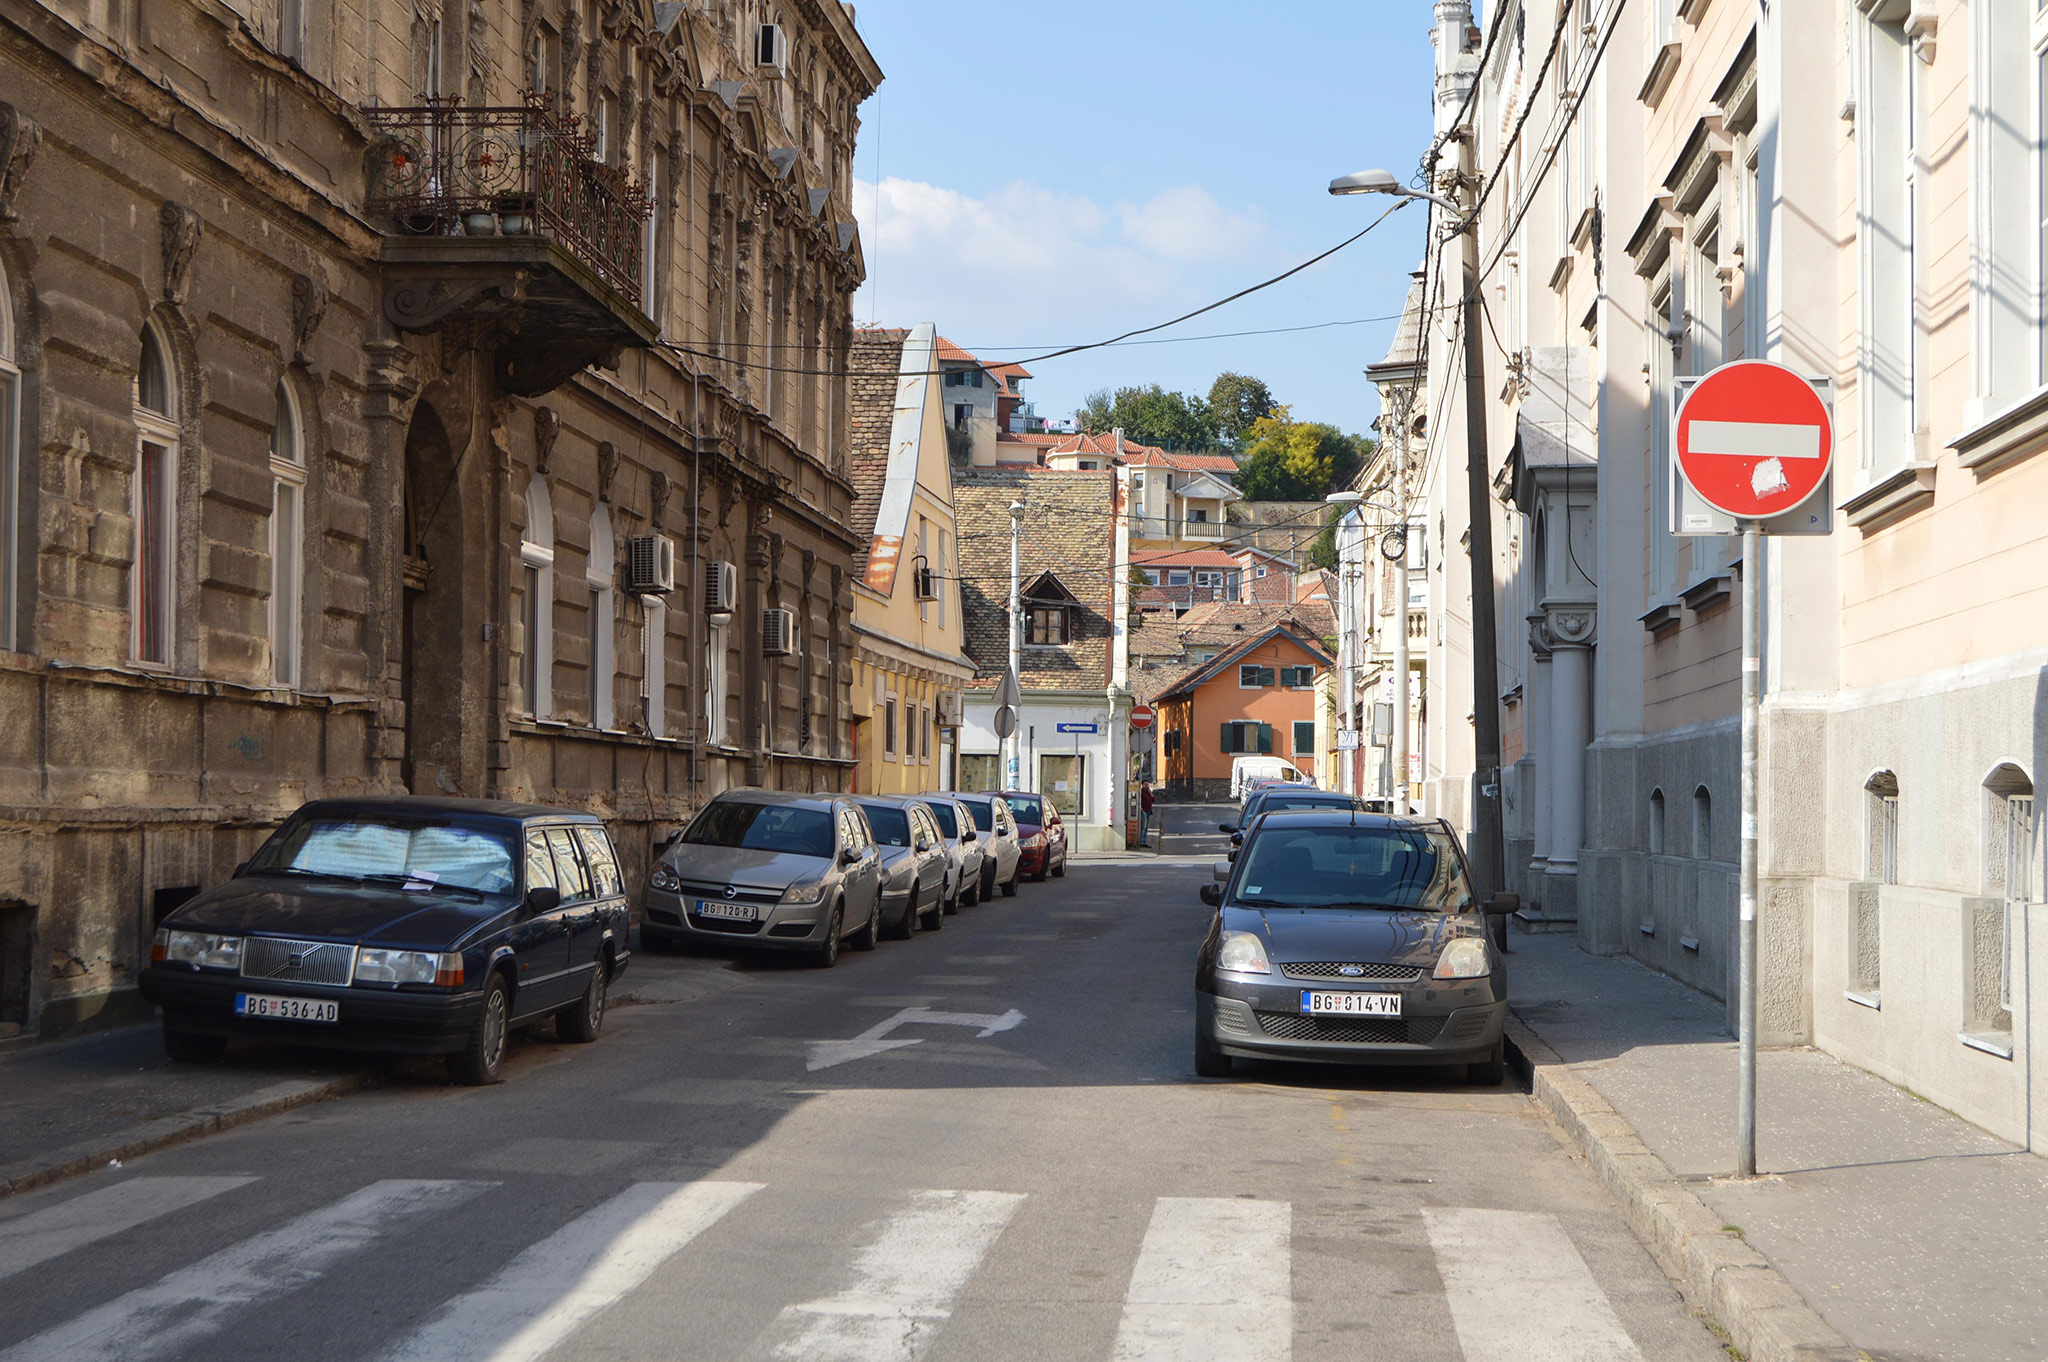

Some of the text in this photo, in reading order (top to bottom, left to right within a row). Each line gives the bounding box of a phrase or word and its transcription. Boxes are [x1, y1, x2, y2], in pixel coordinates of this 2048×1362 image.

[704, 903, 716, 914] BG
[248, 997, 267, 1014] BG
[1313, 995, 1332, 1010] BG
